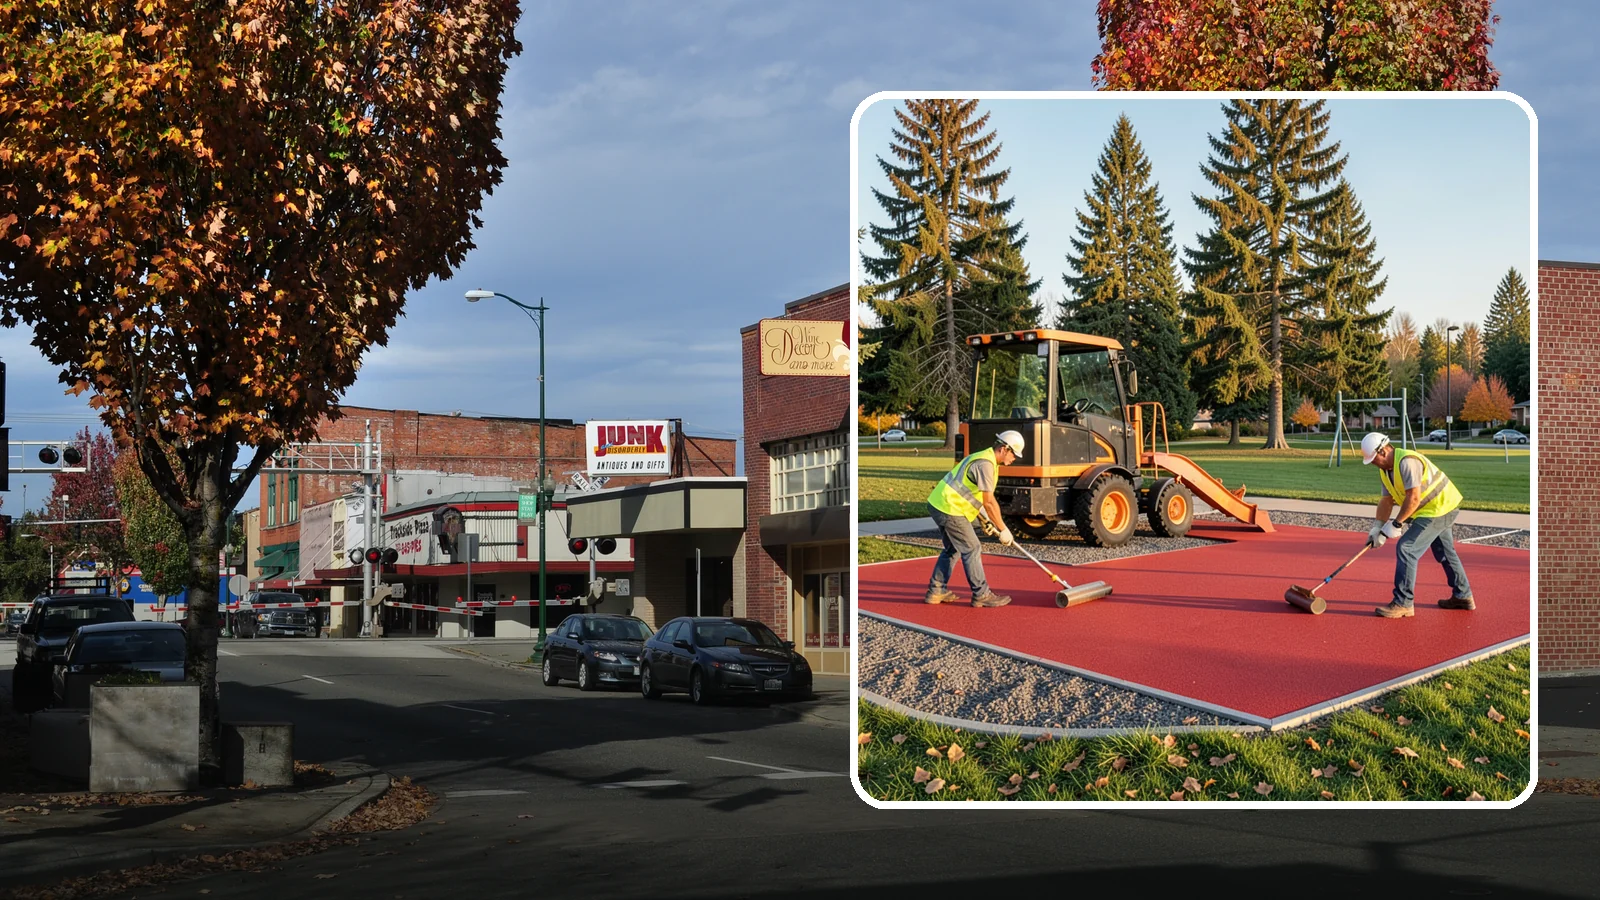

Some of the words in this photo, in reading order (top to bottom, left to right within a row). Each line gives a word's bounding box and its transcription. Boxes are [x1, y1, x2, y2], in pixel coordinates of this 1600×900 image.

[595, 425, 665, 457] JUNK
[607, 446, 646, 454] DISORDERLY
[597, 461, 628, 470] ANTIQUES
[631, 461, 643, 470] AND
[647, 460, 665, 470] GIFTS
[390, 521, 413, 539] Trackside
[415, 520, 429, 535] Pizza
